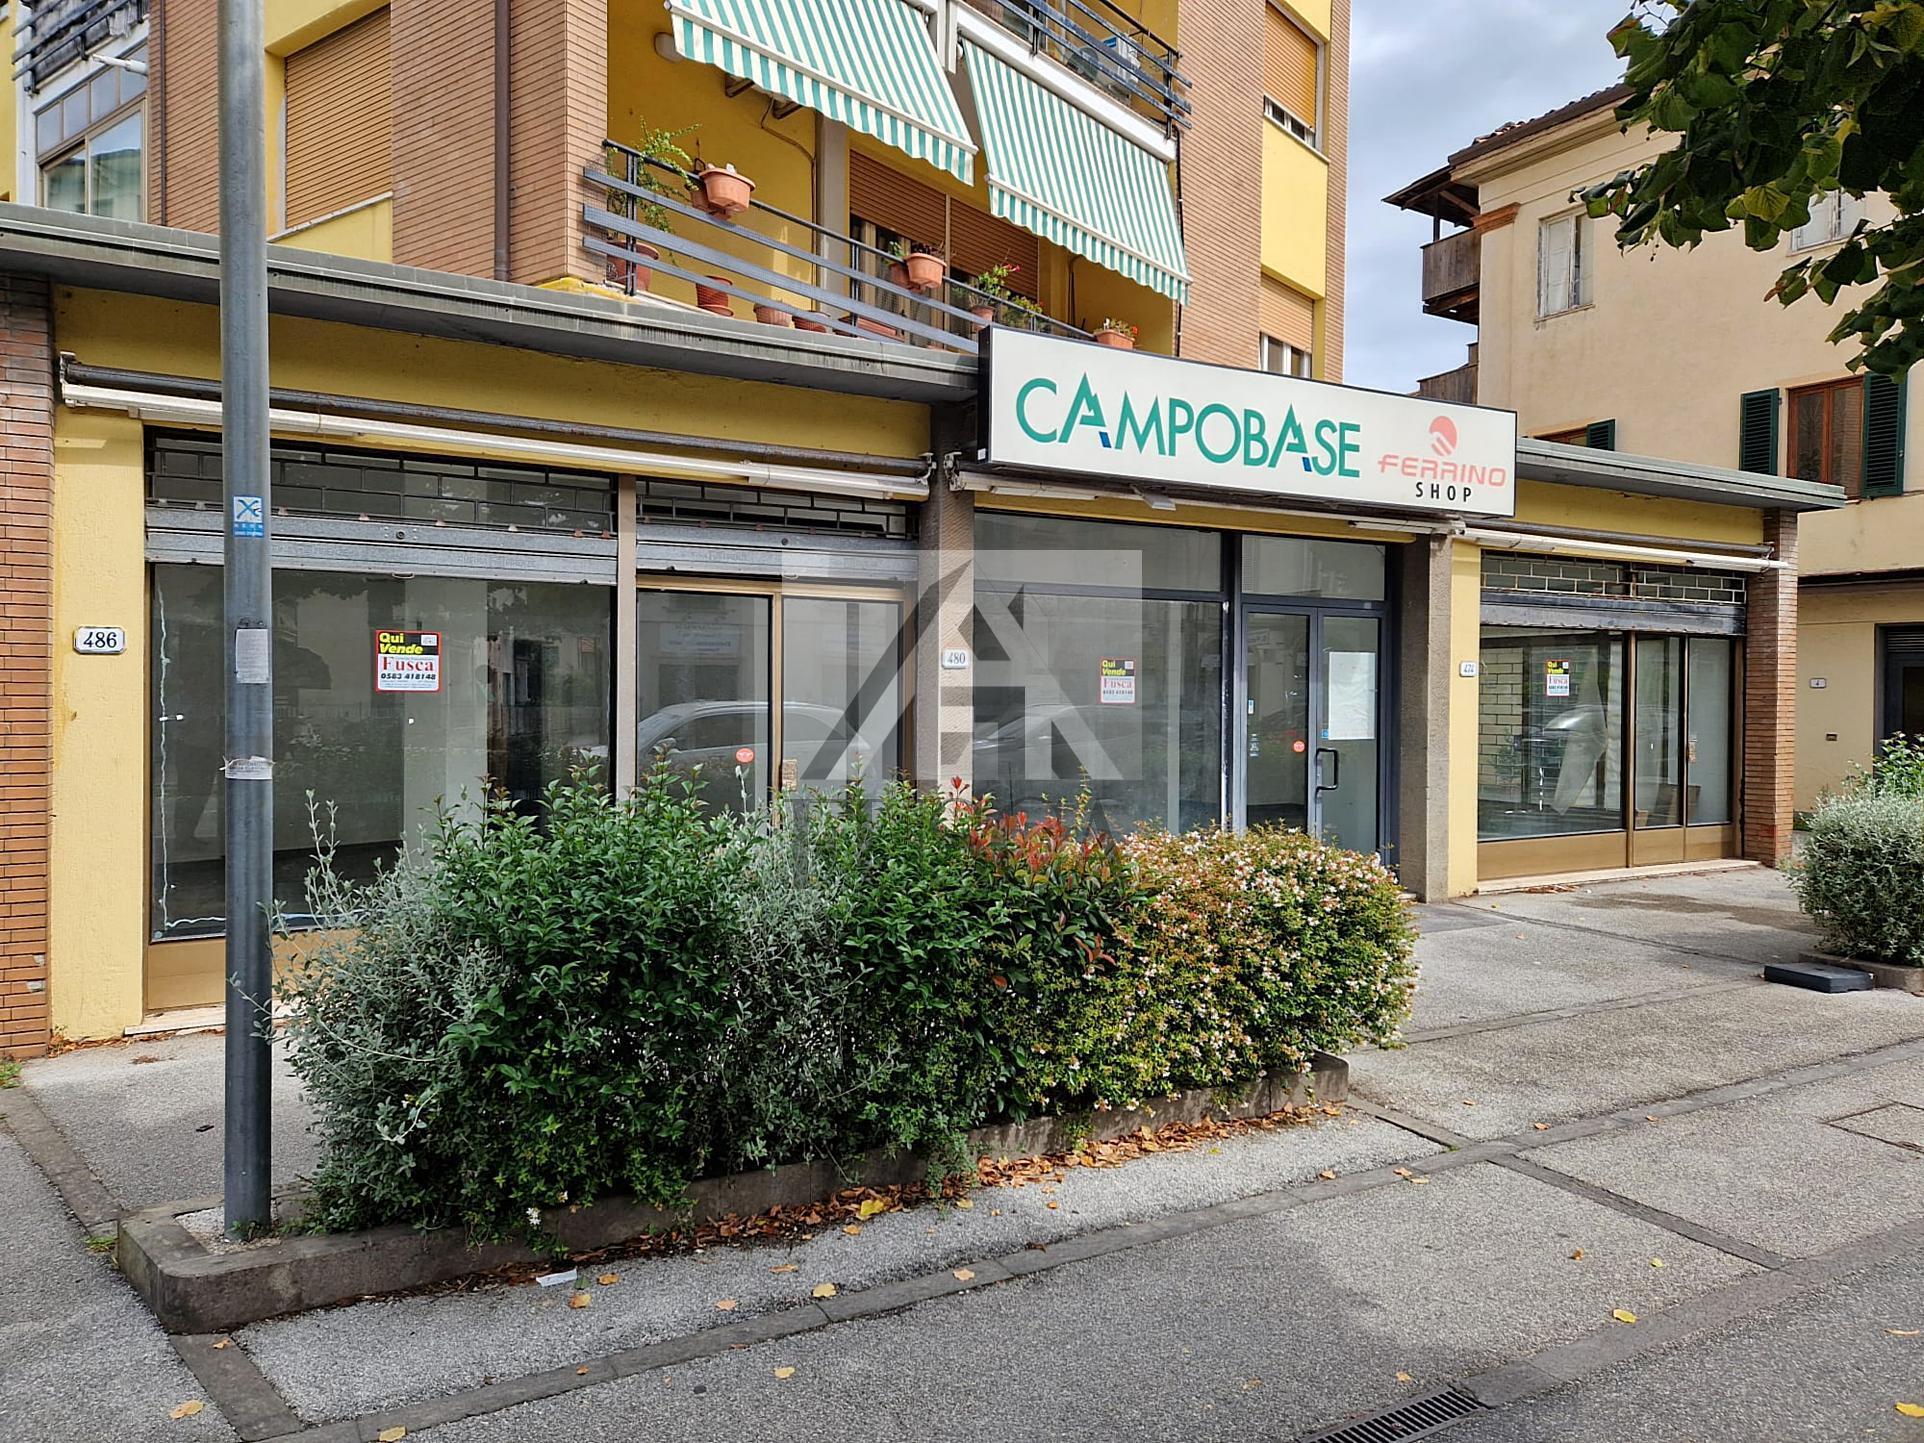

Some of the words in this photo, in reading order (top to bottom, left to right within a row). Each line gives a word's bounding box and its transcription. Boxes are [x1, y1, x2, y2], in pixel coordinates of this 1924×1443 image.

[1015, 372, 1361, 478] CAMPOBASE
[1377, 454, 1507, 488] FERRINO
[1415, 481, 1473, 503] SHOP
[83, 631, 117, 648] 486
[379, 632, 404, 643] Qui
[379, 643, 424, 654] Vende
[382, 656, 434, 671] Fusca
[947, 651, 966, 664] 480
